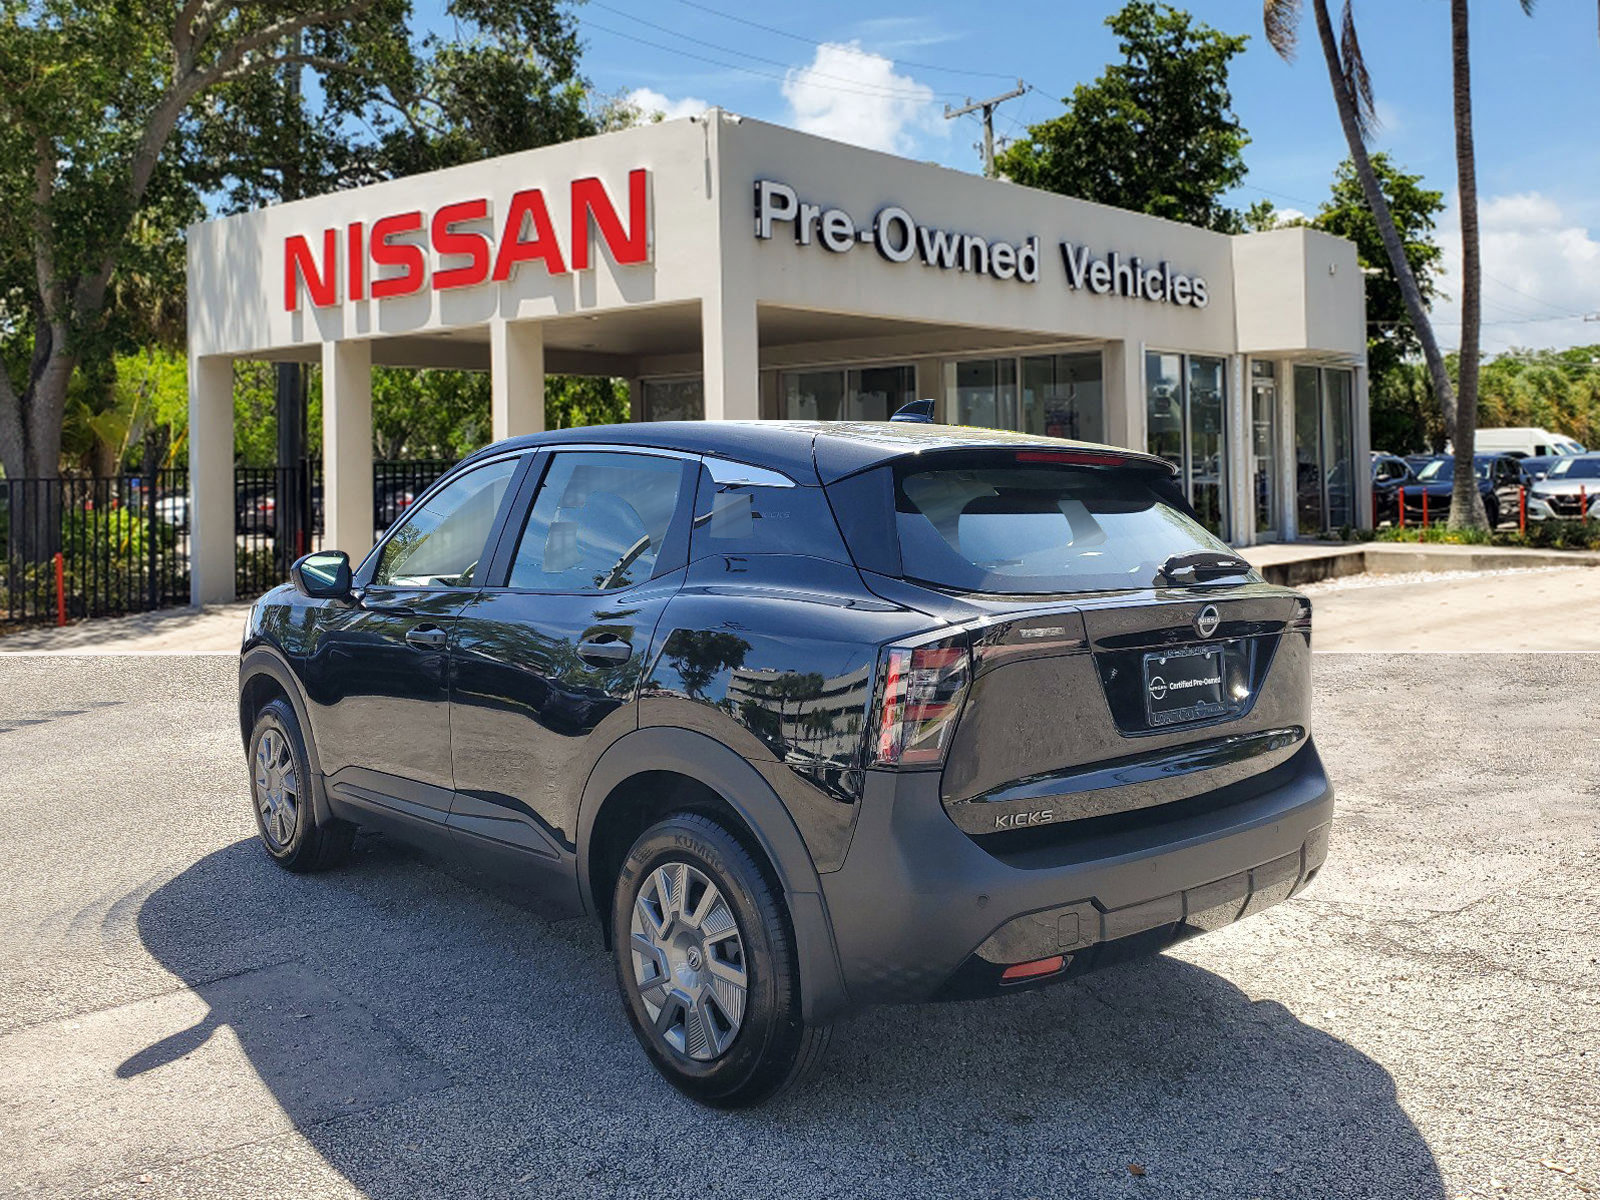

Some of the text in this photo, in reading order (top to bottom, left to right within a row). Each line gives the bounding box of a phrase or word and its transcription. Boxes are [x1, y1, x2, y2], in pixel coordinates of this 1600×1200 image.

[285, 168, 647, 312] NISSAN
[754, 180, 1209, 308] Pre-Owned Vehicles
[1169, 676, 1221, 691] Certified Pre-Owned
[995, 809, 1054, 828] KICKS
